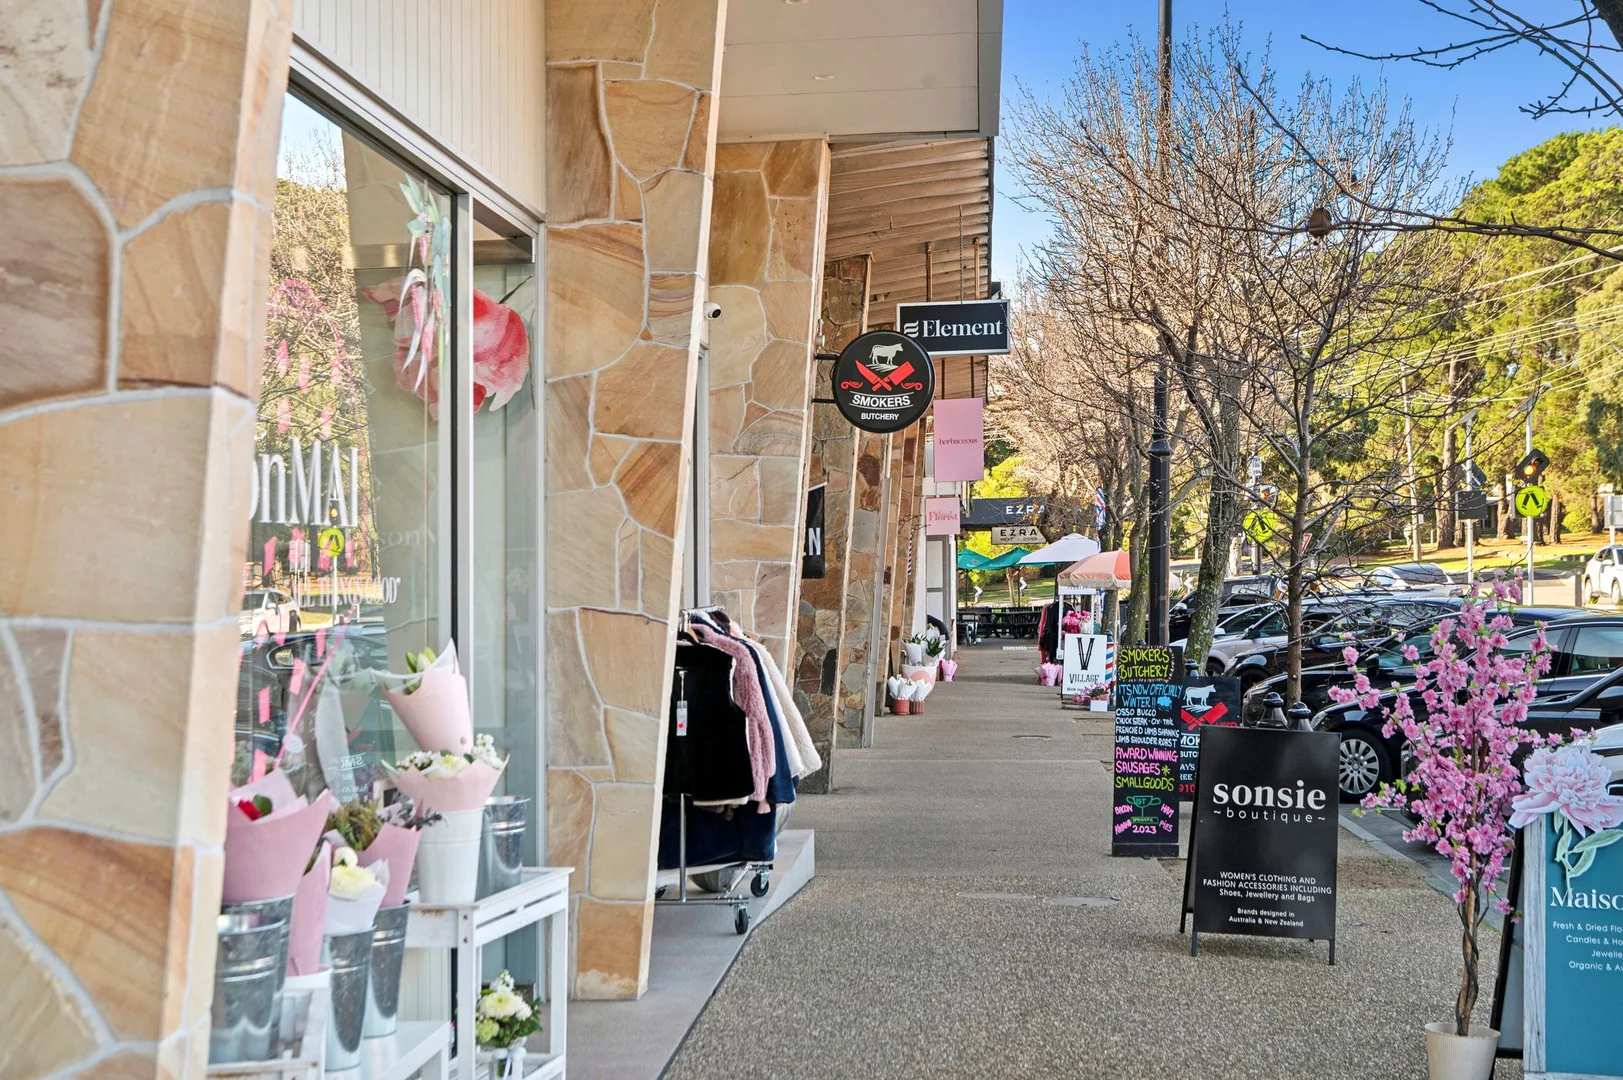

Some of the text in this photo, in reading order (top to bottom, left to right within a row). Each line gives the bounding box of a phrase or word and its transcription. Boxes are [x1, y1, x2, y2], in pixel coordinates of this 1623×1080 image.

[922, 319, 1003, 338] Element
[852, 395, 911, 408] SMOKERS
[861, 412, 900, 421] BUTCHERY
[939, 437, 978, 446] herbaceous
[1005, 504, 1045, 515] EZRA
[928, 510, 959, 522] Florist
[1000, 528, 1038, 537] EZRA
[1077, 637, 1095, 670] V
[1119, 648, 1170, 665] SMOKERS
[1119, 664, 1169, 680] BUTCHERY
[1069, 673, 1099, 684] VILLAGE
[1132, 683, 1150, 695] NOW
[1149, 683, 1183, 699] OFFICIALLY
[1115, 708, 1157, 717] OSSO BUCCO
[1115, 717, 1133, 725] CHUCK
[1133, 717, 1149, 726] STEAK
[1144, 728, 1157, 736] LAMB
[1157, 728, 1180, 738] SHANKS
[1115, 736, 1177, 748] LAMB SHOULDER ROAST
[1115, 747, 1179, 763] AWARD WINNING
[1115, 760, 1160, 775] SAUSAGES
[1115, 776, 1175, 792] SMALLGOODS
[1212, 779, 1327, 811] sonsie
[1114, 805, 1133, 815] BACON
[1160, 803, 1175, 818] HAM
[1132, 825, 1157, 834] 2023
[1158, 820, 1173, 833] PIES
[1219, 871, 1316, 885] WOMEN'S CLOTHING AND
[1202, 878, 1332, 894] FASHION ACCESSORIES INCLUDING
[1219, 888, 1315, 903] Shoes, Jewellery and Bags
[1237, 907, 1295, 918] Brands designed in
[1228, 915, 1256, 925] Australia
[1279, 918, 1304, 928] Zealand
[1552, 921, 1623, 933] Fresh & Dried Flo
[1565, 934, 1601, 945] Candles
[1603, 937, 1610, 945] &
[1568, 960, 1603, 971] Organic
[1605, 963, 1612, 971] &
